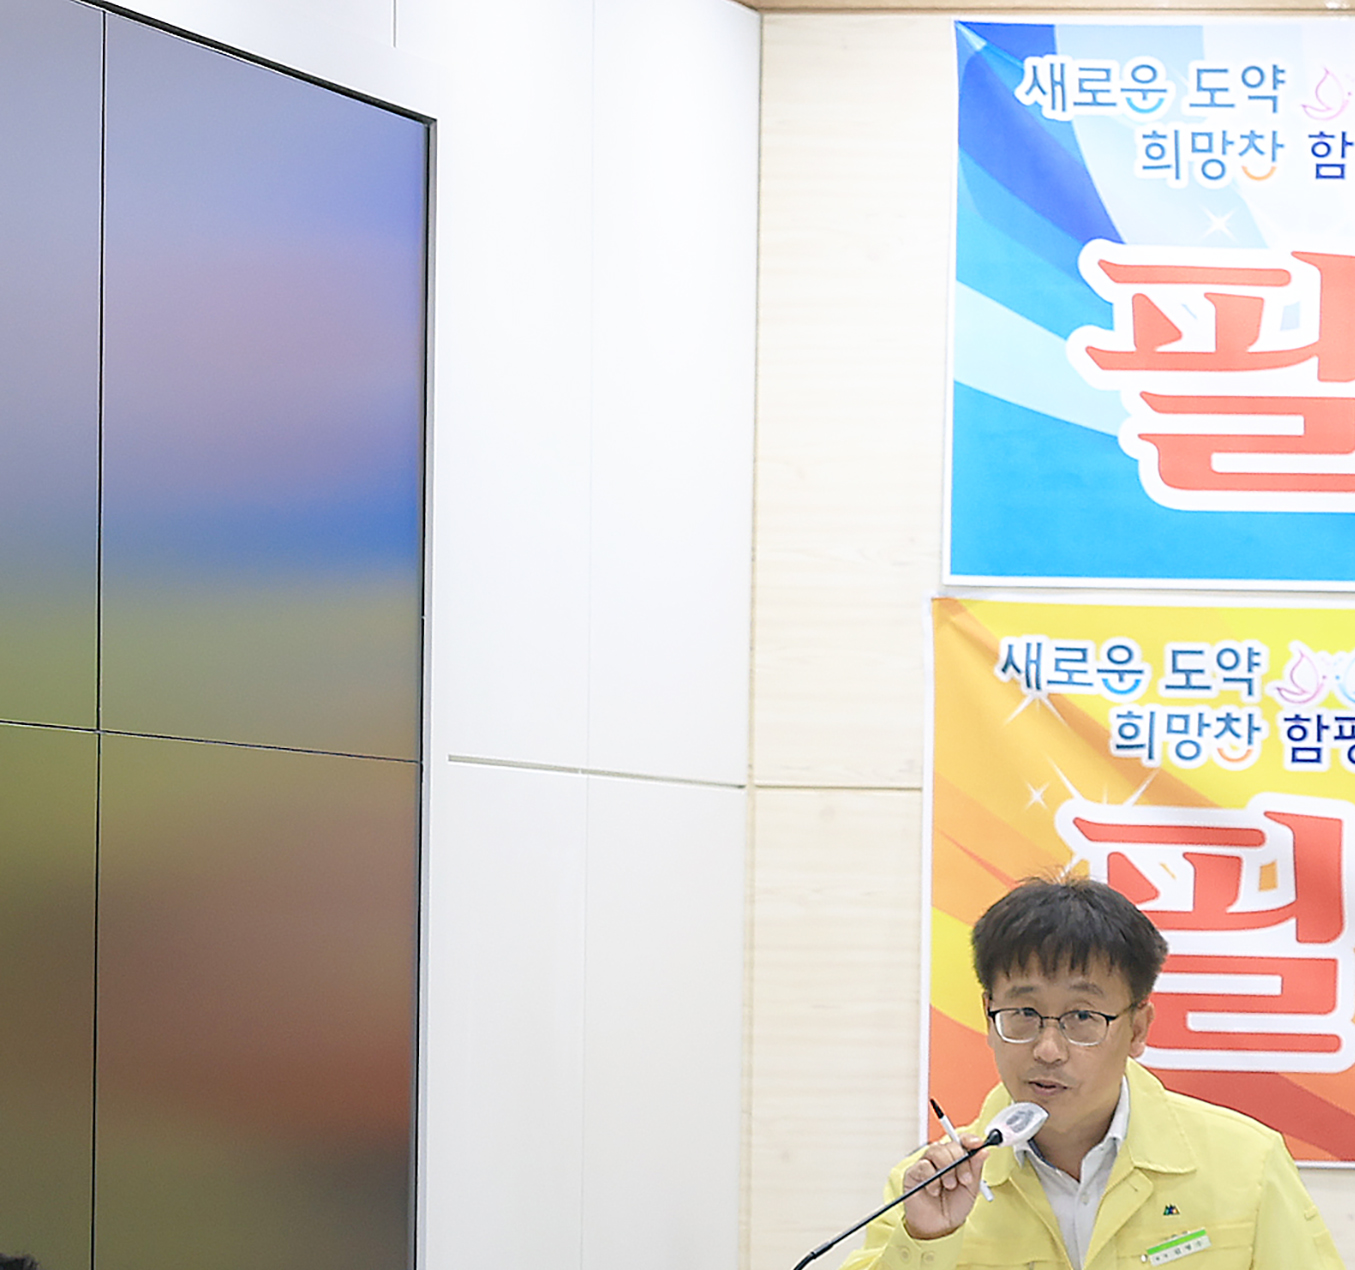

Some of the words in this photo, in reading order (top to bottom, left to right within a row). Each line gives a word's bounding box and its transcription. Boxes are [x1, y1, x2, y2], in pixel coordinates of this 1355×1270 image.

[1022, 61, 1168, 114] 새로운
[1188, 63, 1287, 114] 도약
[1141, 129, 1285, 181] 희망찬
[1001, 640, 1145, 696] 새로운
[1163, 645, 1262, 697] 도약
[1114, 709, 1261, 763] 희망찬
[1073, 811, 1345, 1053] 필
